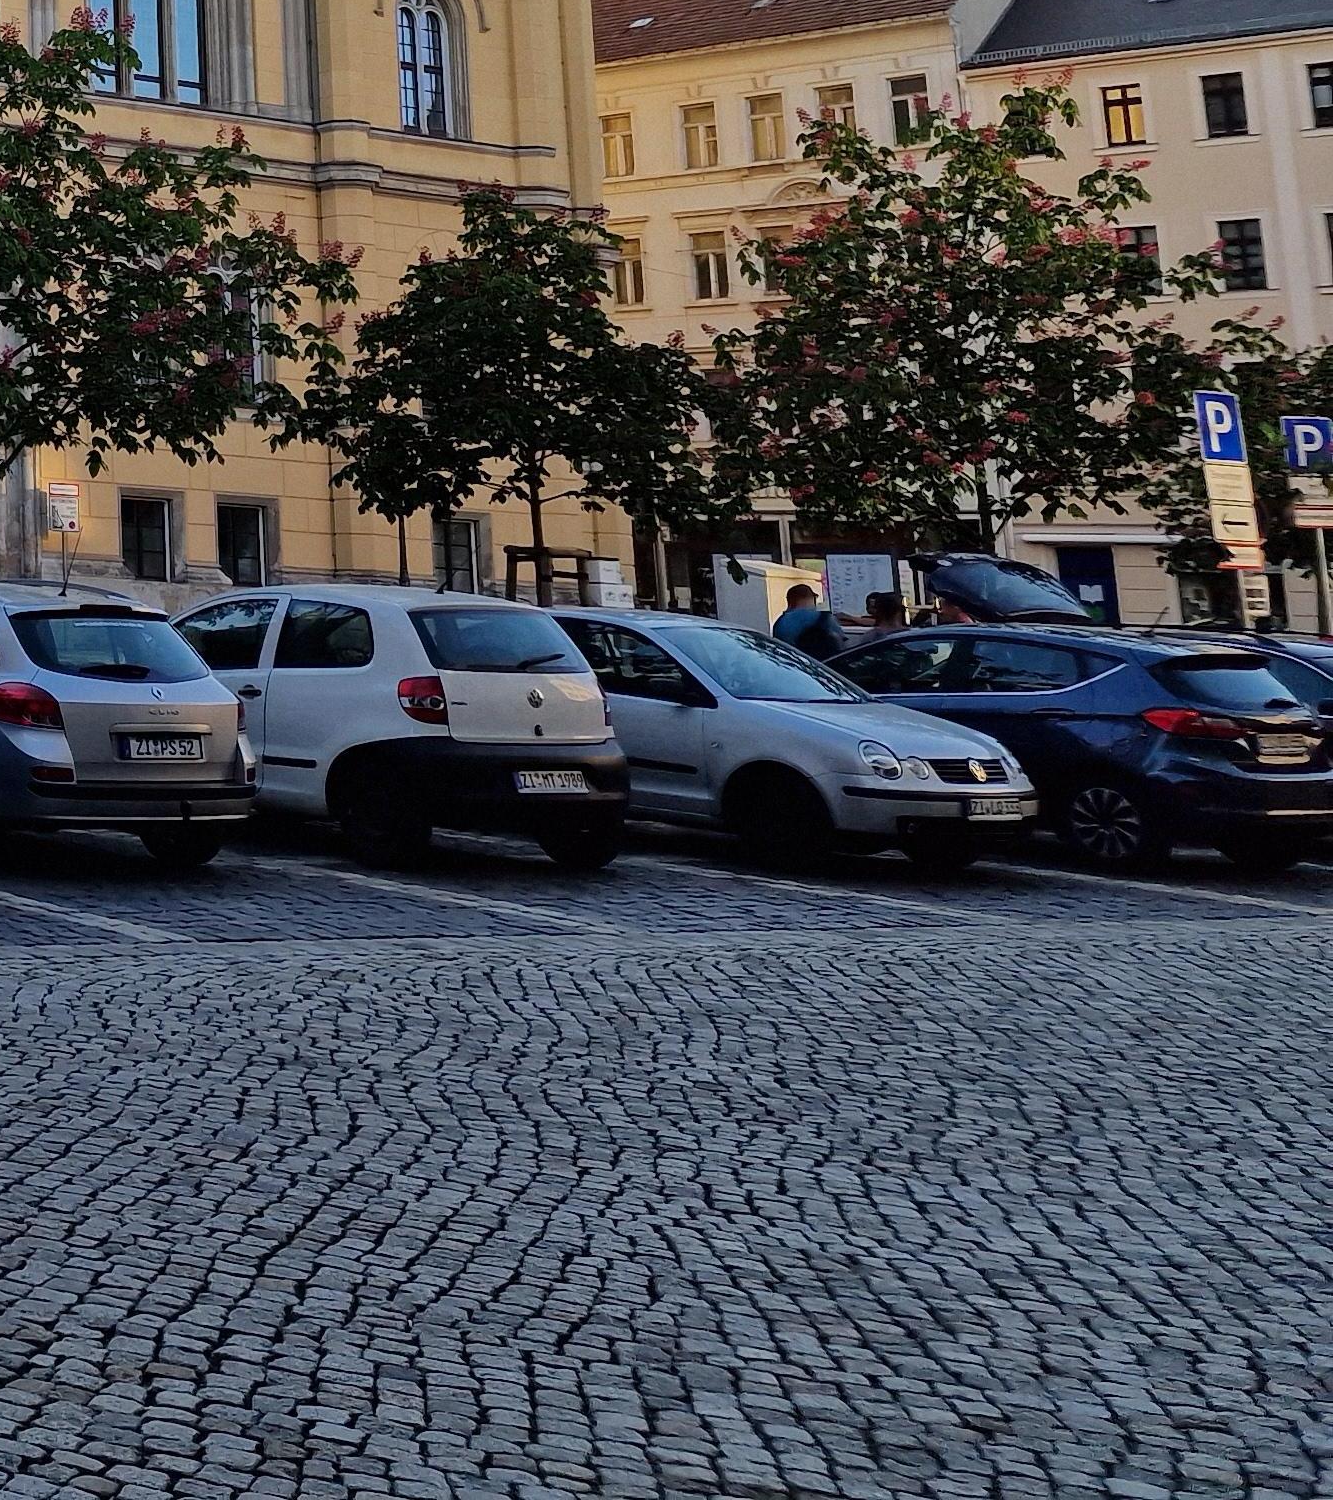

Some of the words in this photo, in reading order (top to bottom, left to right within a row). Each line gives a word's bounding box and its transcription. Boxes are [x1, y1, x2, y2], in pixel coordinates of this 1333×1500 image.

[1205, 401, 1232, 453] P
[1293, 424, 1324, 467] P
[136, 739, 153, 756] ZI
[160, 739, 177, 756] PS
[179, 739, 196, 756] 52
[520, 773, 537, 789] ZI
[543, 773, 556, 789] MT
[557, 772, 584, 788] 1989
